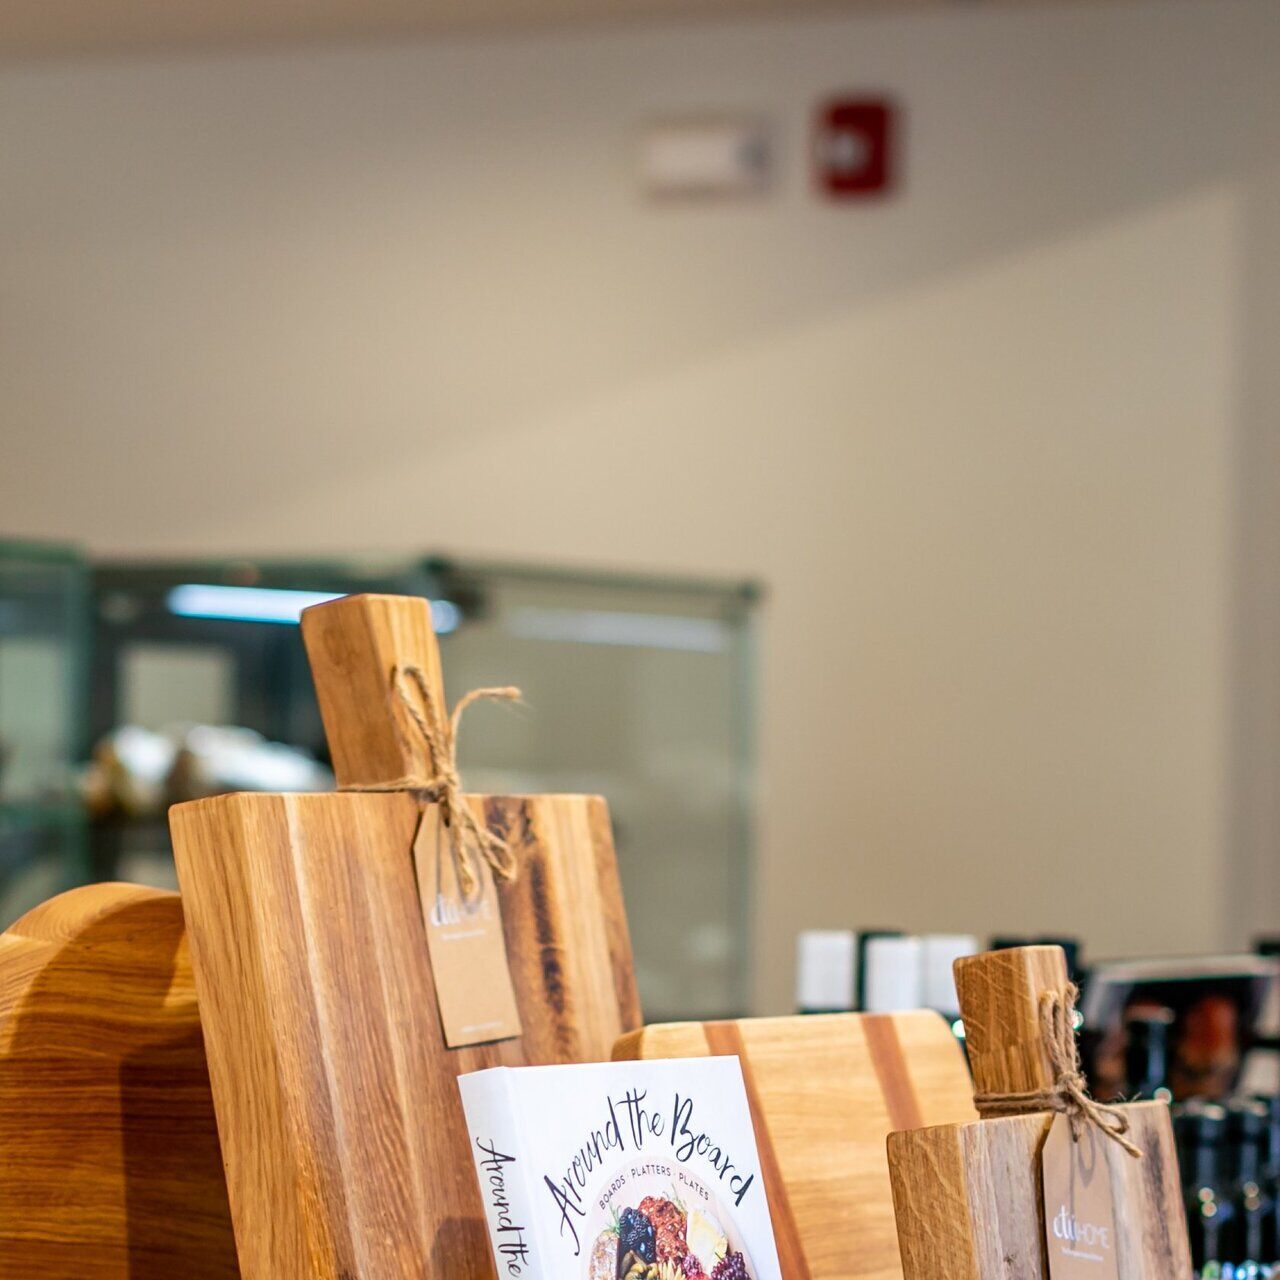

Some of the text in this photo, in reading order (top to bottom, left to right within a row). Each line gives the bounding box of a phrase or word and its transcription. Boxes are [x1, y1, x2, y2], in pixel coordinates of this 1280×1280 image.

[476, 1137, 525, 1232] Around
[544, 1087, 754, 1256] Around the Board
[599, 1164, 709, 1210] BOARDS PLATTERS PLATES
[498, 1229, 529, 1278] the
